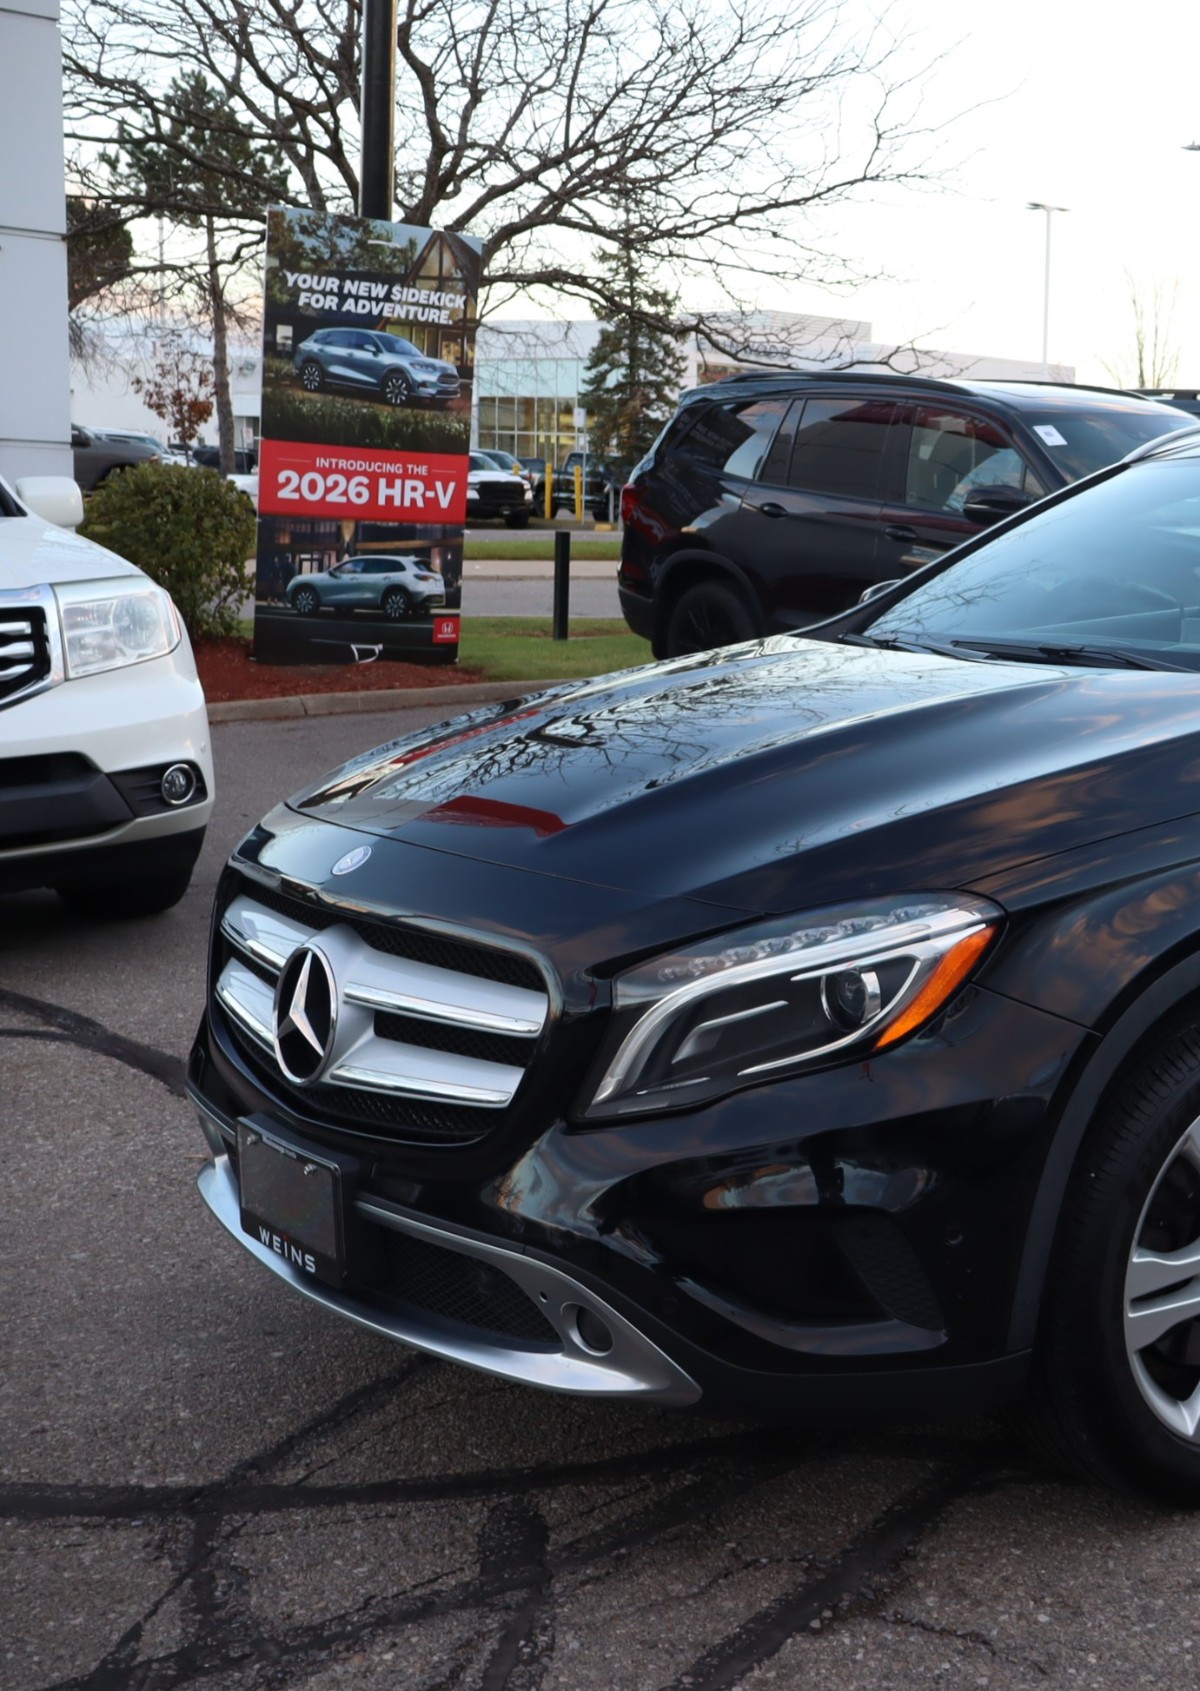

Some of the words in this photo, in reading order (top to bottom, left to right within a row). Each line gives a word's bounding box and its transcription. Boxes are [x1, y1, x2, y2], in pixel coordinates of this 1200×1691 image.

[285, 271, 340, 293] YOUR
[343, 280, 389, 299] NEW
[390, 285, 467, 310] SIDEKICK
[298, 292, 339, 311] FOR
[341, 299, 454, 325] ADVENTURE.
[315, 457, 404, 474] INTRODUCING
[407, 464, 429, 476] THE
[277, 469, 371, 505] 2026
[377, 477, 457, 509] HR-V
[258, 1225, 316, 1273] WEINS
